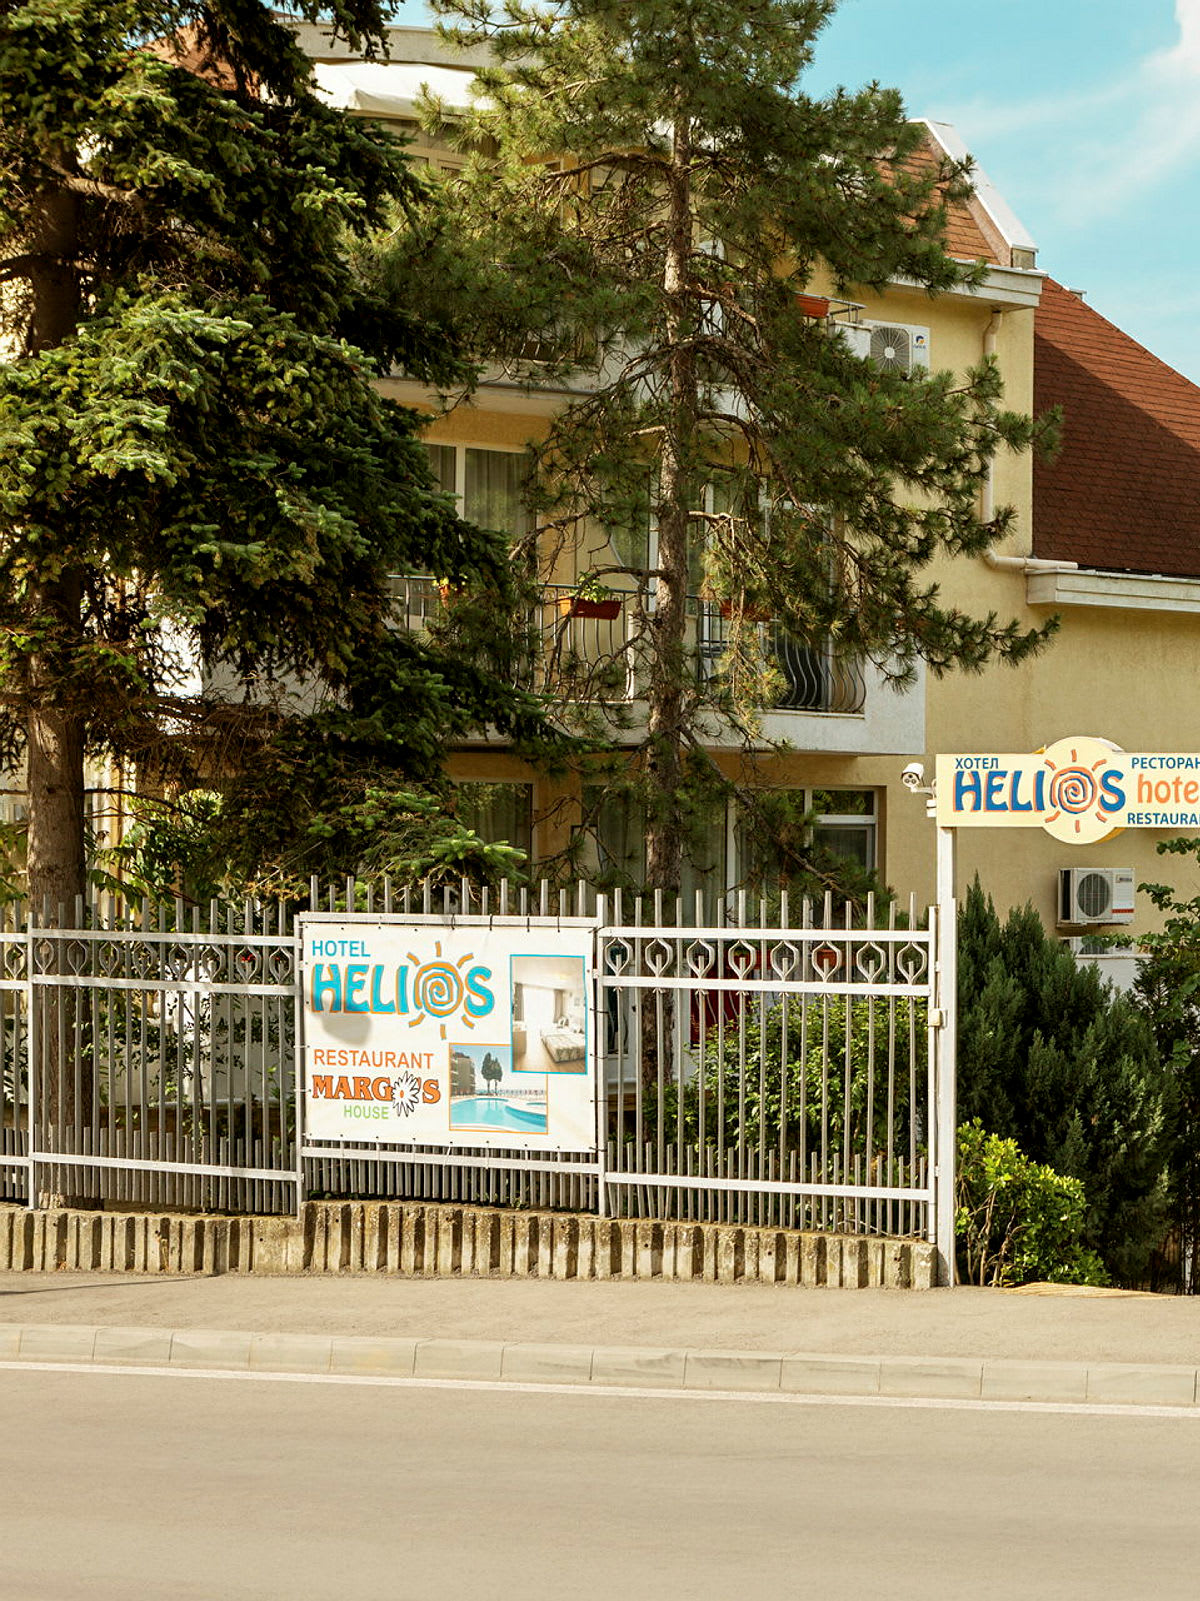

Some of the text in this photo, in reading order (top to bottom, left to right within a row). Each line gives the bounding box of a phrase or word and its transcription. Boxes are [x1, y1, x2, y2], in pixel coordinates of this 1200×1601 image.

[955, 757, 999, 770] ХОТЕЛ
[953, 767, 1127, 814] HELIOS
[312, 940, 371, 957] HOTEL
[311, 961, 495, 1018] HELIOS
[314, 1048, 435, 1070] RESTAURANT
[343, 1104, 390, 1120] HOUSE
